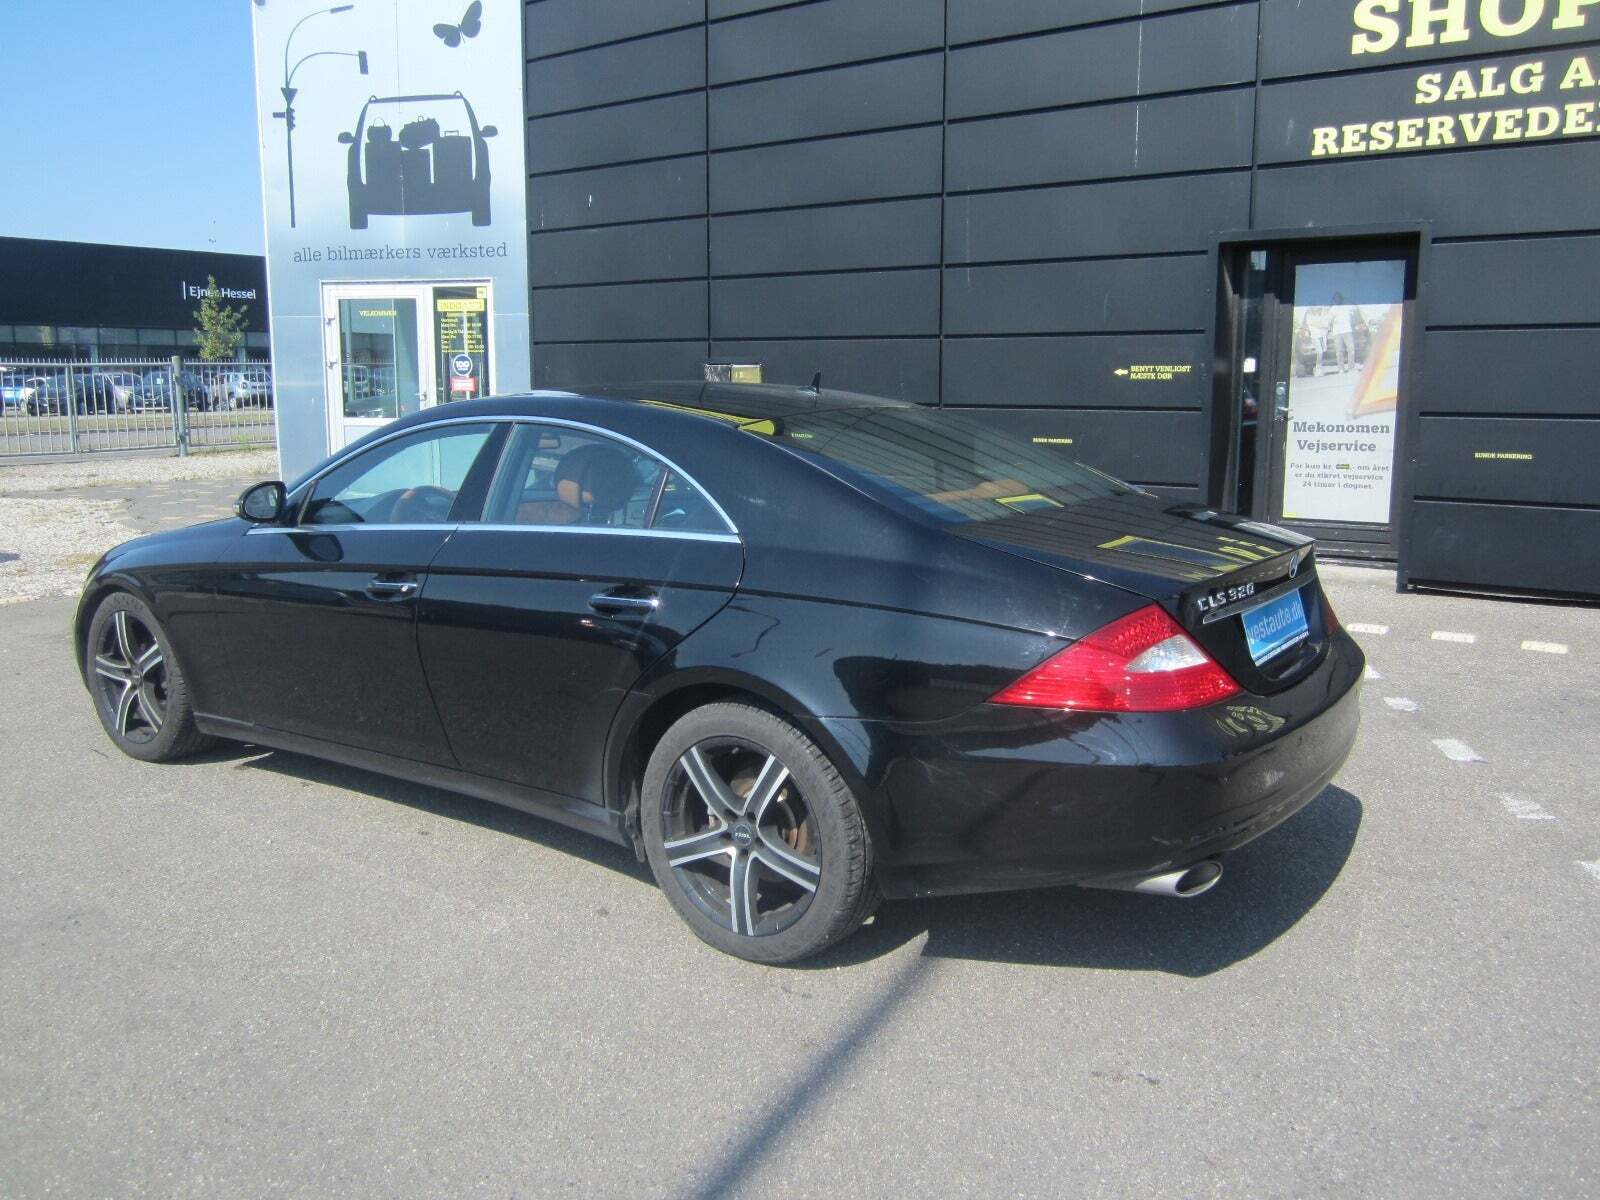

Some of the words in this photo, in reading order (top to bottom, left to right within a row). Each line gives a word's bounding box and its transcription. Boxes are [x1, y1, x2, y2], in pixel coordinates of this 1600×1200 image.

[1415, 61, 1545, 104] SALG
[1559, 56, 1600, 90] A
[1311, 101, 1600, 156] RESERVEDE
[293, 247, 322, 263] alle
[326, 244, 421, 261] bilmærkers
[427, 242, 508, 259] værksted
[221, 288, 256, 299] Hessel
[1130, 372, 1156, 380] NÆSTE
[1157, 372, 1173, 380] DØR
[1155, 365, 1192, 373] VENLIGST
[1292, 421, 1390, 434] Mekonomen
[1296, 440, 1377, 453] Vejservice
[1197, 592, 1227, 611] CLS
[1228, 582, 1255, 600] 320
[1246, 601, 1305, 640] vestauto.dk
